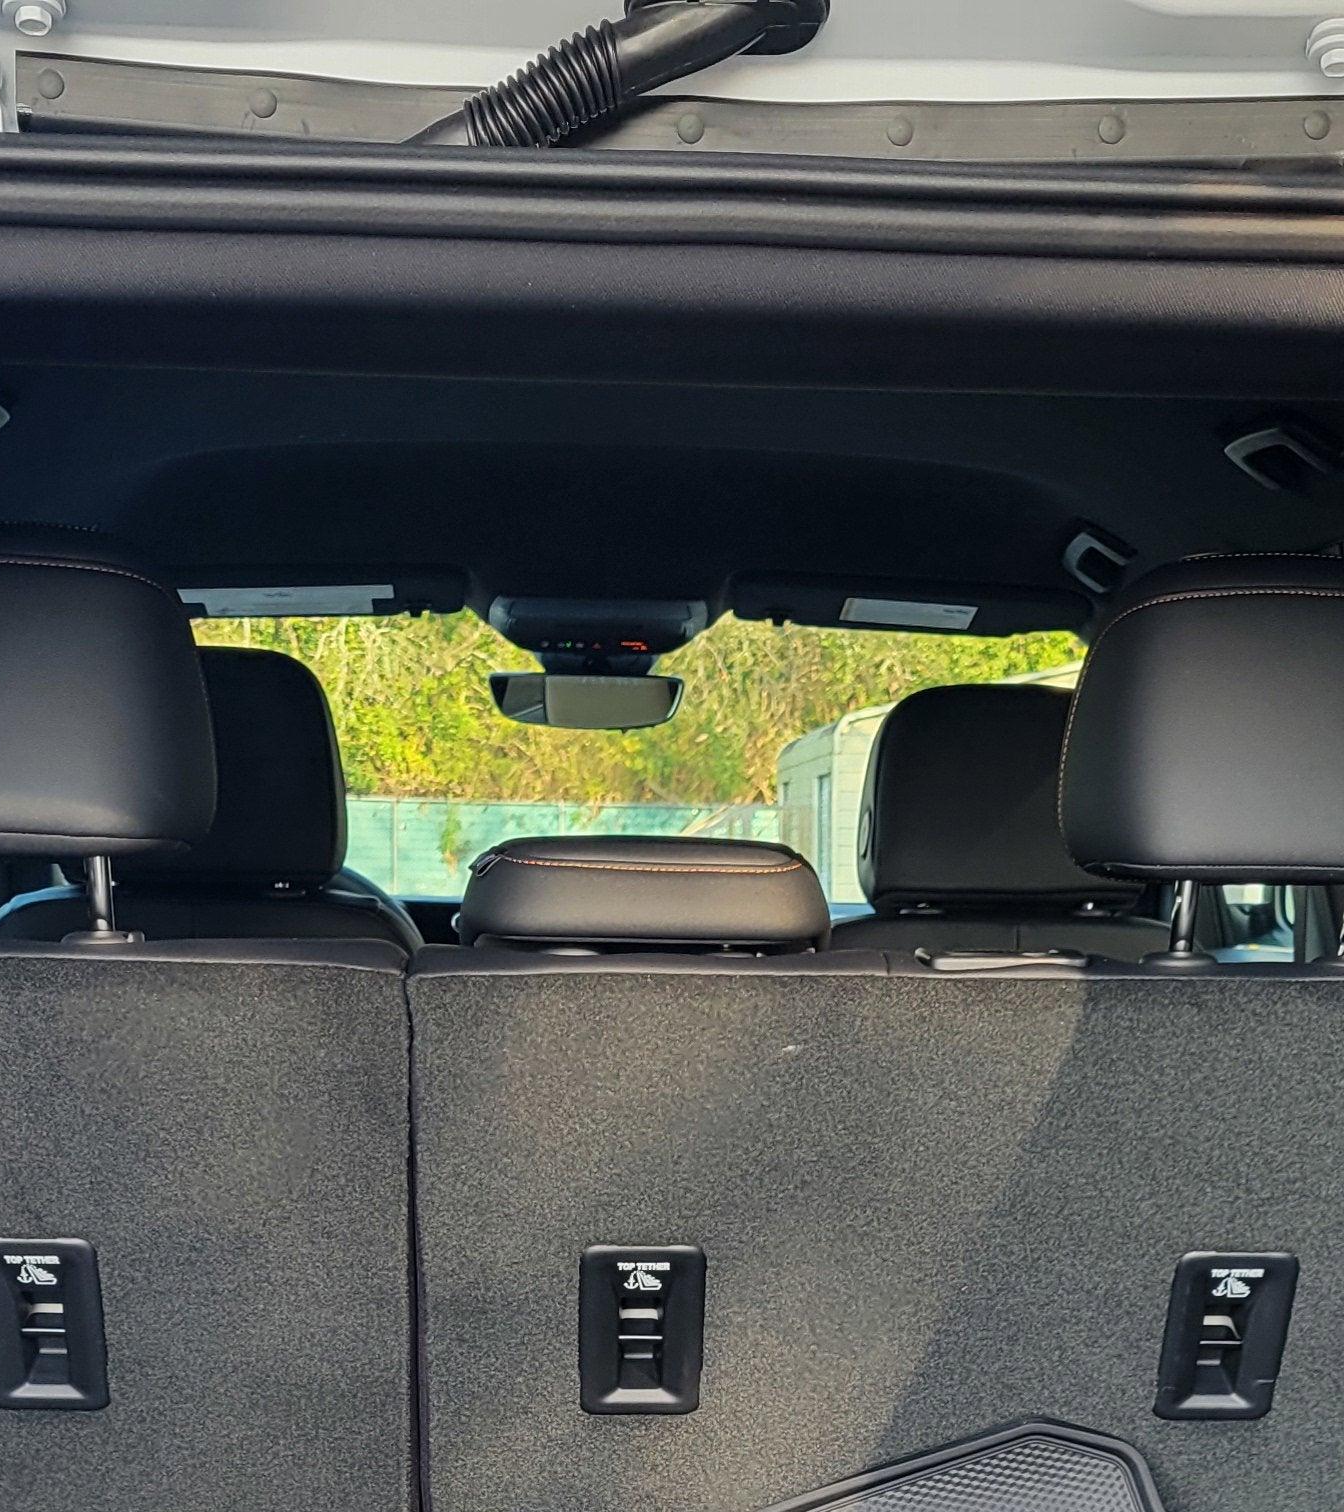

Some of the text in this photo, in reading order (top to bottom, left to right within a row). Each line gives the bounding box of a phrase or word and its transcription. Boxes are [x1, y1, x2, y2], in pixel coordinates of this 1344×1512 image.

[3, 1255, 61, 1264] TOP TETHER
[617, 1262, 670, 1271] TOP TETHER
[1211, 1268, 1265, 1278] TOP TETHER
